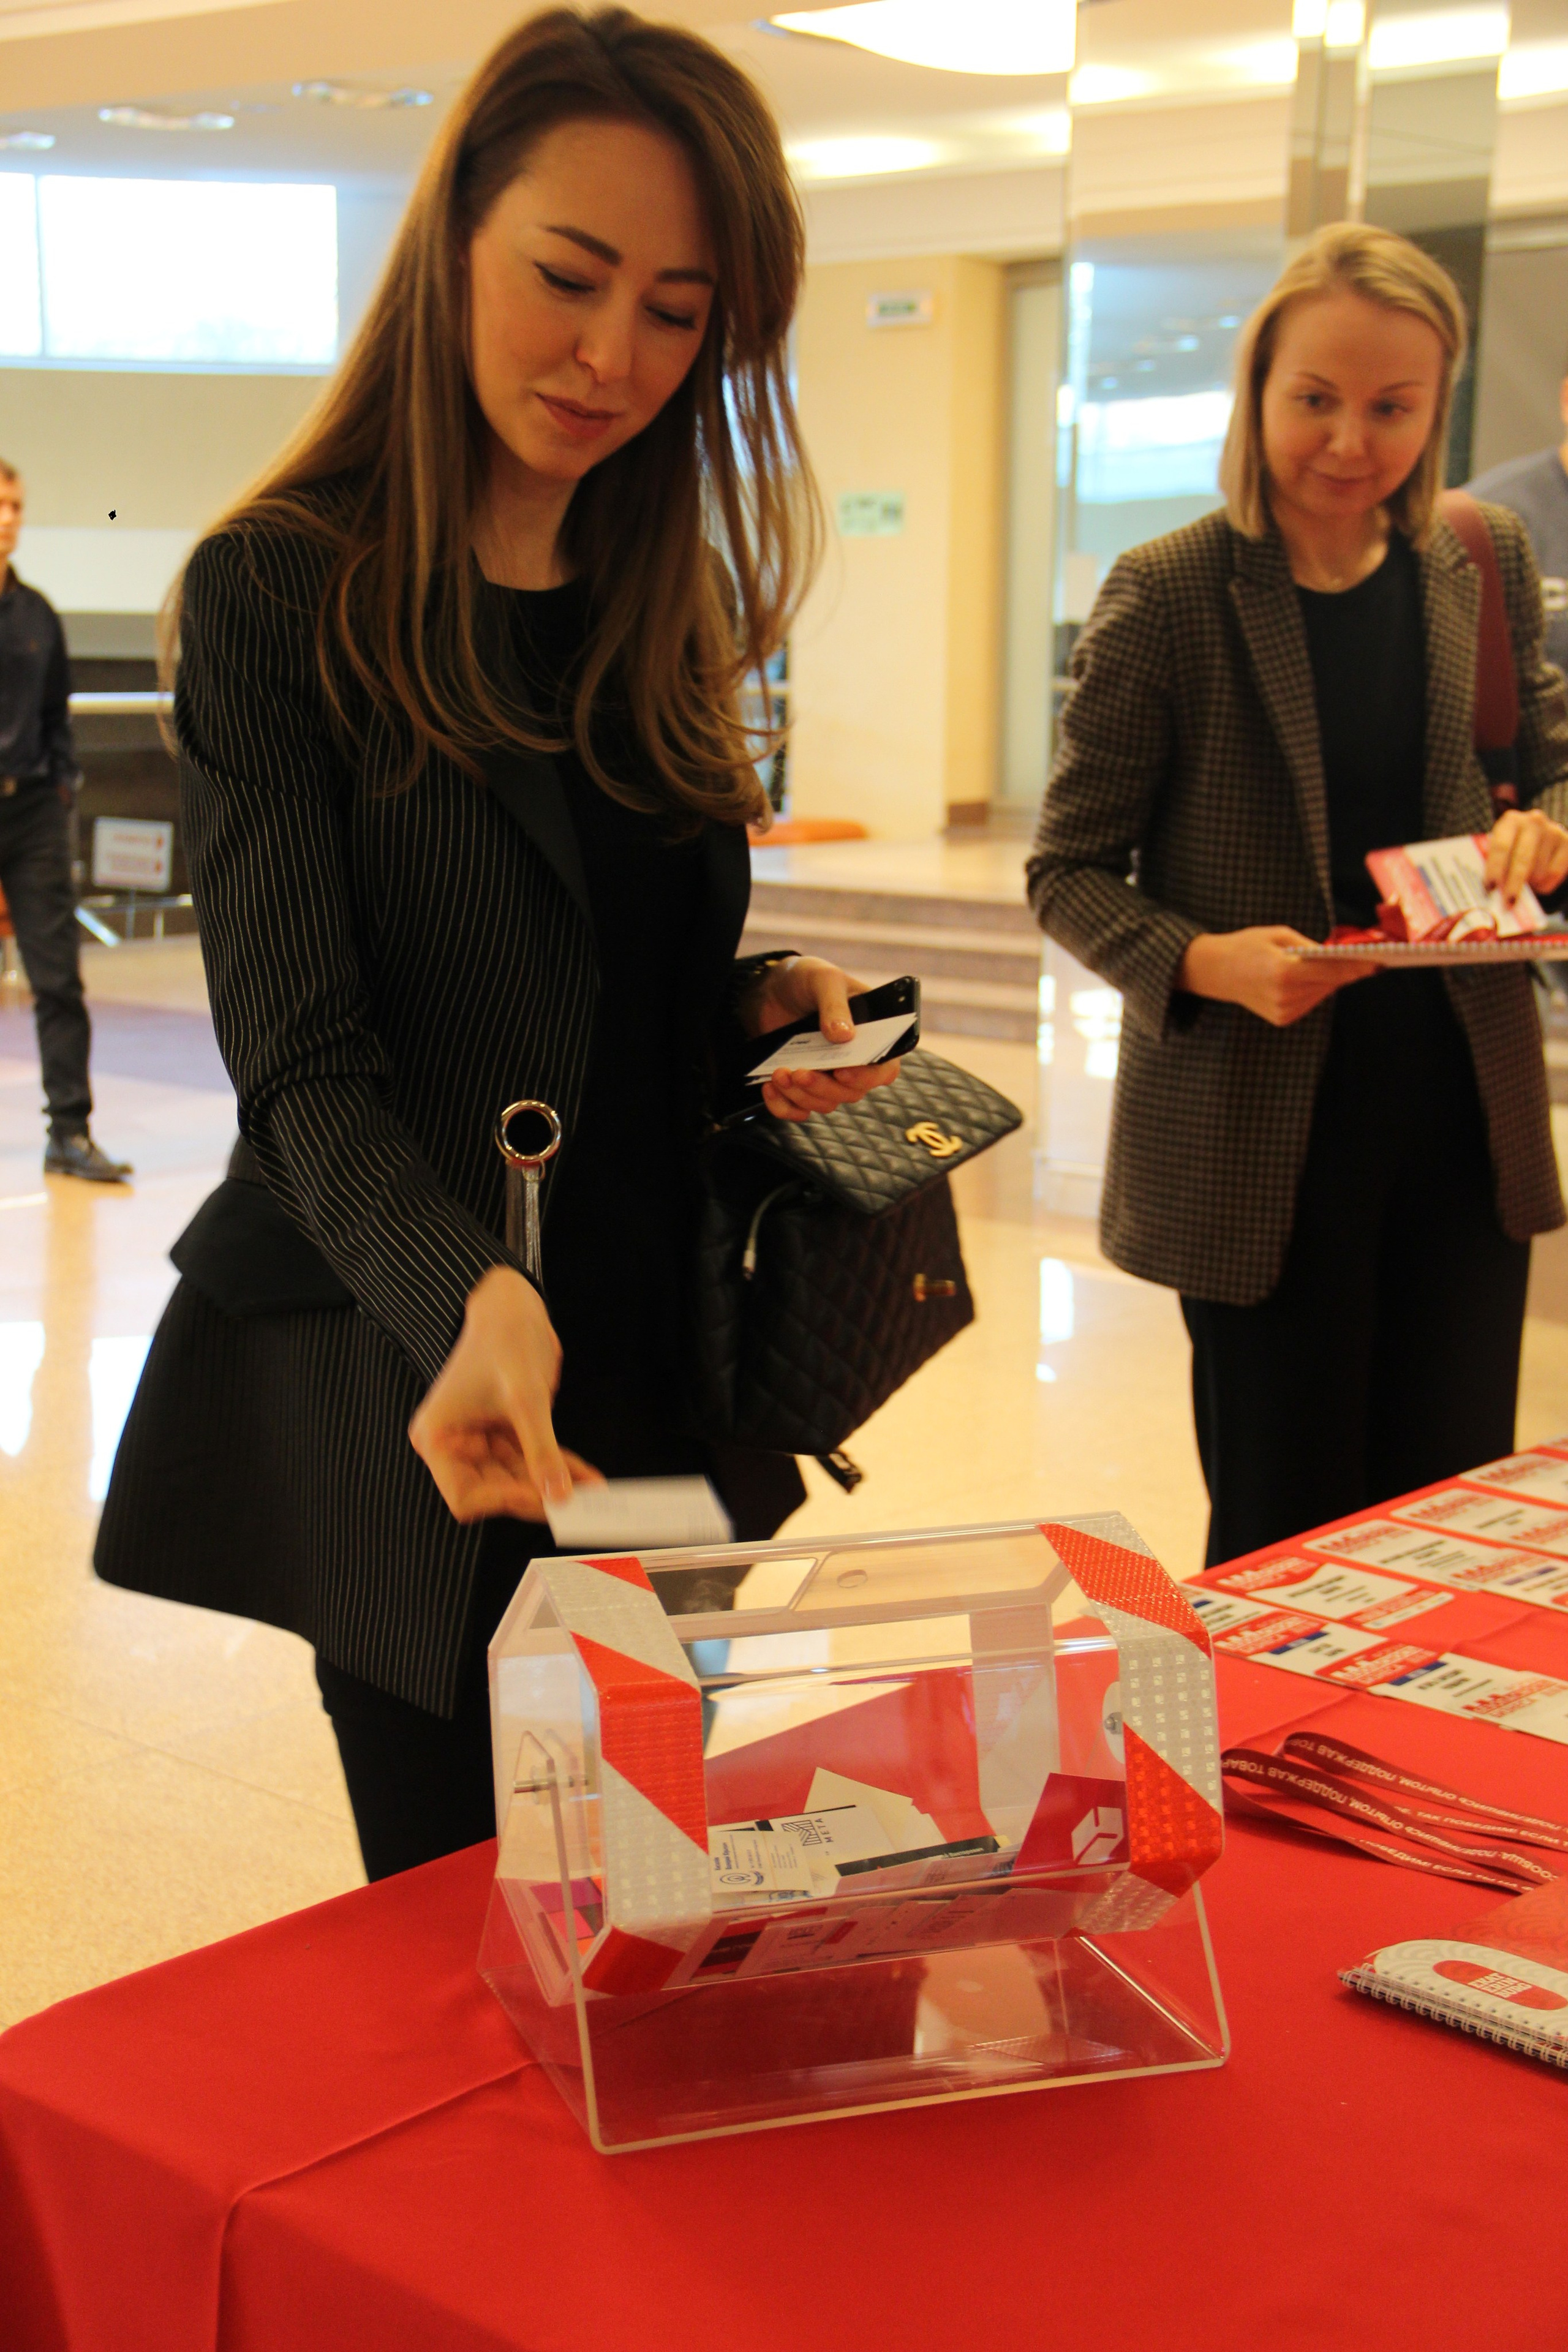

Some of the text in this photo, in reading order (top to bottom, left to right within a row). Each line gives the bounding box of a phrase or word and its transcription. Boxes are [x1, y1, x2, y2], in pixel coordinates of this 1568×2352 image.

[1317, 1744, 1396, 1781] ПОДДЕРЖАВ
[1267, 1766, 1348, 1804] ПОДДЕРЖАВ
[1349, 1796, 1404, 1830] ОПЫТОМ,
